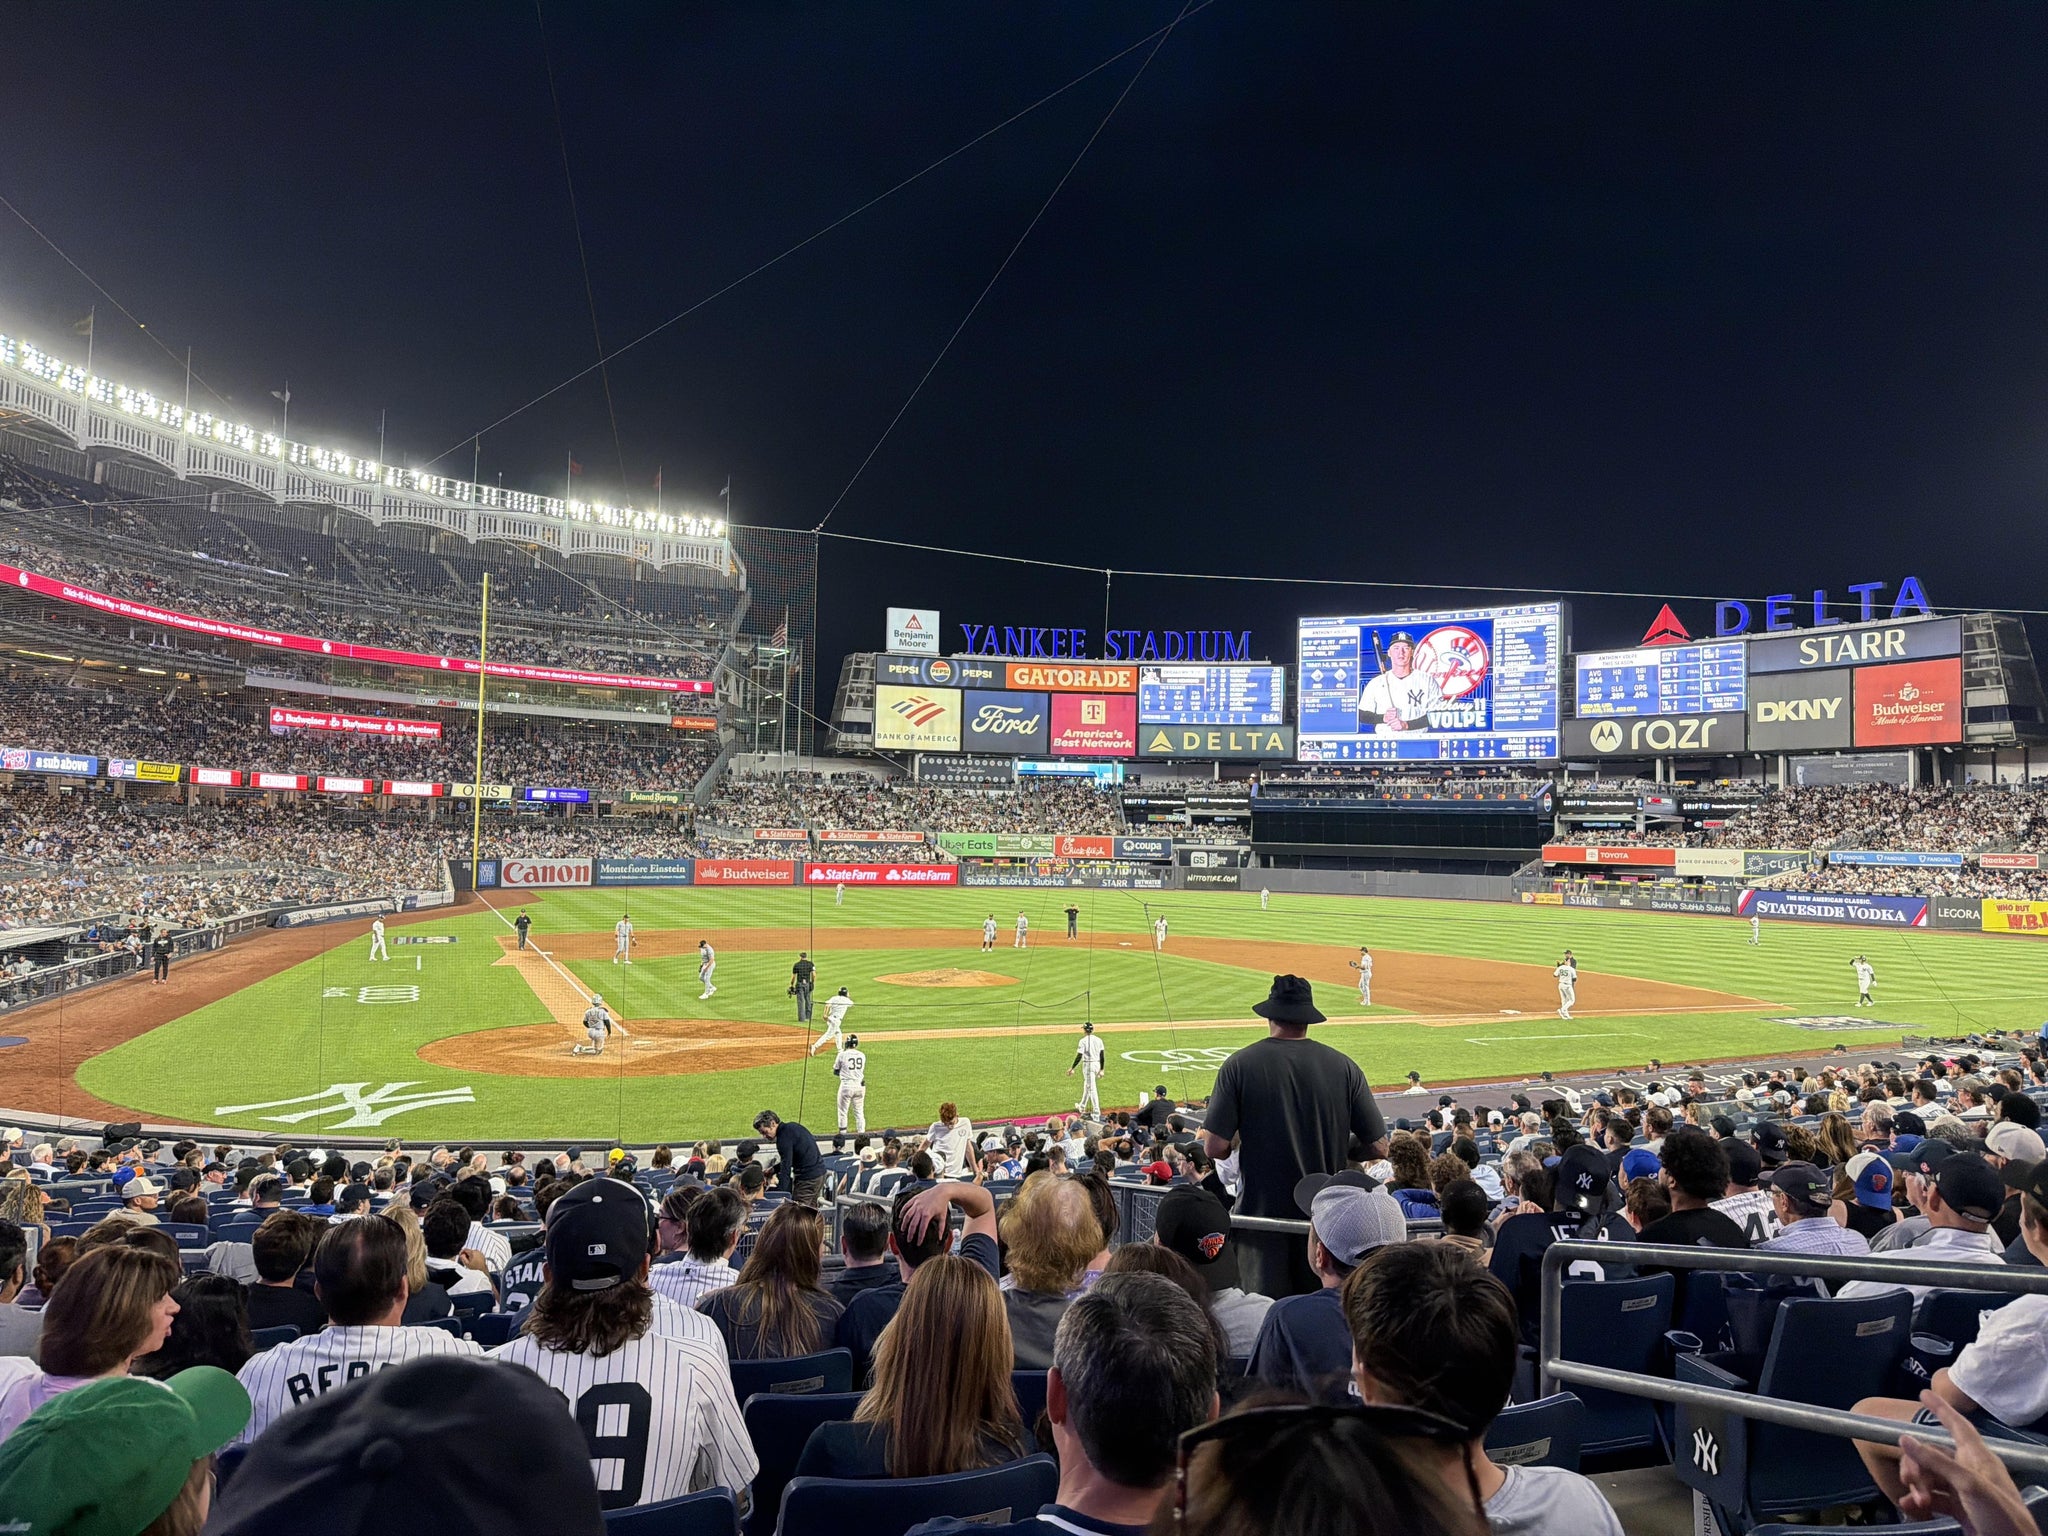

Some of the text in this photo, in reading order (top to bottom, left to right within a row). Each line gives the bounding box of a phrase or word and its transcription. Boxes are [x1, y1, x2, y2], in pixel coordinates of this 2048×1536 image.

[120, 603, 131, 612] 500
[1716, 576, 1931, 637] DELTA
[894, 629, 933, 640] Benjamin
[899, 639, 926, 648] Moore
[959, 623, 1253, 661] YANKEE STADIUM
[1799, 629, 1906, 665] STARR
[889, 664, 919, 675] PEPSI
[962, 669, 993, 679] PEPSI
[1014, 667, 1131, 688] GATORADE
[1474, 698, 1486, 711] 11
[1757, 697, 1842, 723] DKNY
[1872, 701, 1945, 717] Budweiser
[285, 713, 440, 735] Budweiser Budweiser Budweiser
[685, 720, 715, 728] Budweiser
[971, 704, 1040, 735] Ford
[1427, 711, 1487, 729] VOLPE
[1871, 715, 1943, 726] Made of America
[877, 733, 901, 741] BANK
[917, 735, 958, 743] AMERICA
[1063, 729, 1123, 739] America's
[1631, 718, 1718, 750] razr
[1053, 738, 1133, 748] Best Network
[1183, 732, 1285, 751] DELTA
[36, 756, 89, 772] a sub above
[462, 786, 500, 798] ORIS
[630, 791, 678, 803] Poland Spring
[940, 840, 966, 850] Uber
[967, 840, 994, 850] Eats
[1135, 842, 1162, 852] coupa
[1193, 856, 1205, 864] GS
[1600, 851, 1629, 859] TOYOTA
[1982, 856, 2015, 865] Reebok
[480, 870, 495, 878] YORK
[503, 862, 590, 884] Canon
[600, 864, 686, 873] Montefiore Einstein
[966, 878, 997, 886] StubHub
[999, 878, 1030, 886] StubHub
[1032, 878, 1065, 886] StubHub
[1569, 896, 1598, 906] STARR
[1652, 901, 1731, 913] StubHub StubHub StubHub
[1757, 900, 1906, 922] STATESIDE VODKA
[1939, 907, 1981, 920] LEGORA
[1996, 903, 2030, 913] WHO BUT
[848, 1057, 863, 1070] 39
[1576, 1172, 1594, 1190] NY
